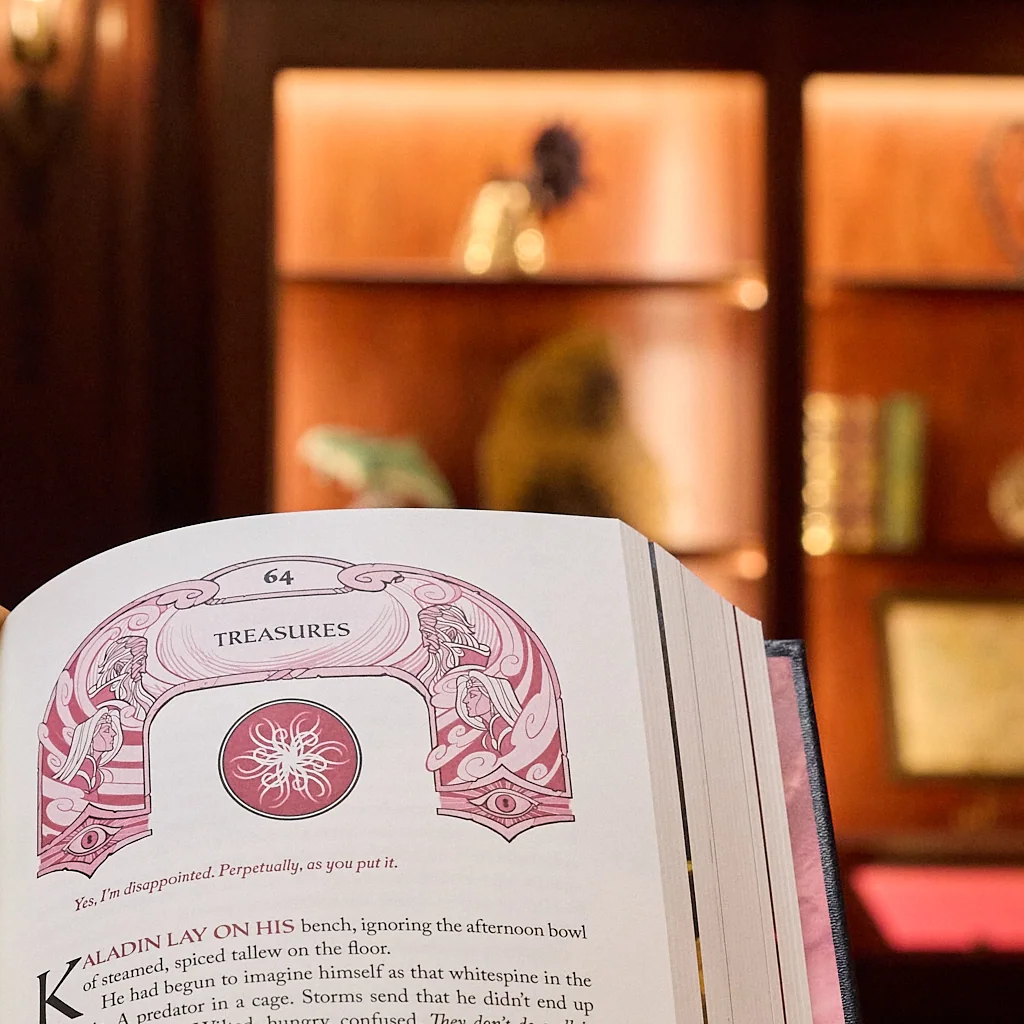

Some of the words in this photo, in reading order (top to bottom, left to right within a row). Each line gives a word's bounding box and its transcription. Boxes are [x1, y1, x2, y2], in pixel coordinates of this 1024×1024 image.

[263, 567, 295, 586] 64
[213, 622, 351, 647] TREASURES
[74, 896, 98, 912] Yes,
[99, 887, 121, 903] I’m
[123, 865, 215, 896] disappointed.
[218, 858, 303, 879] Perpetually,
[306, 860, 323, 870] as
[325, 860, 353, 874] you
[355, 858, 381, 874] put
[384, 858, 398, 869] it.
[167, 926, 208, 947] LAY
[213, 922, 249, 940] ON
[256, 918, 295, 936] HIS
[300, 916, 357, 934] bench,
[360, 917, 433, 937] ignoring
[435, 917, 463, 933] the
[466, 918, 545, 937] afternoon
[547, 922, 588, 940] bowl
[101, 991, 125, 1010] He
[129, 981, 159, 1002] had
[163, 977, 216, 996] begun
[221, 975, 238, 986] to
[243, 967, 313, 987] imagine
[318, 963, 385, 980] himself
[388, 968, 405, 979] as
[410, 964, 444, 980] that
[448, 965, 539, 988] whitespine
[543, 970, 561, 986] in
[565, 971, 592, 988] the
